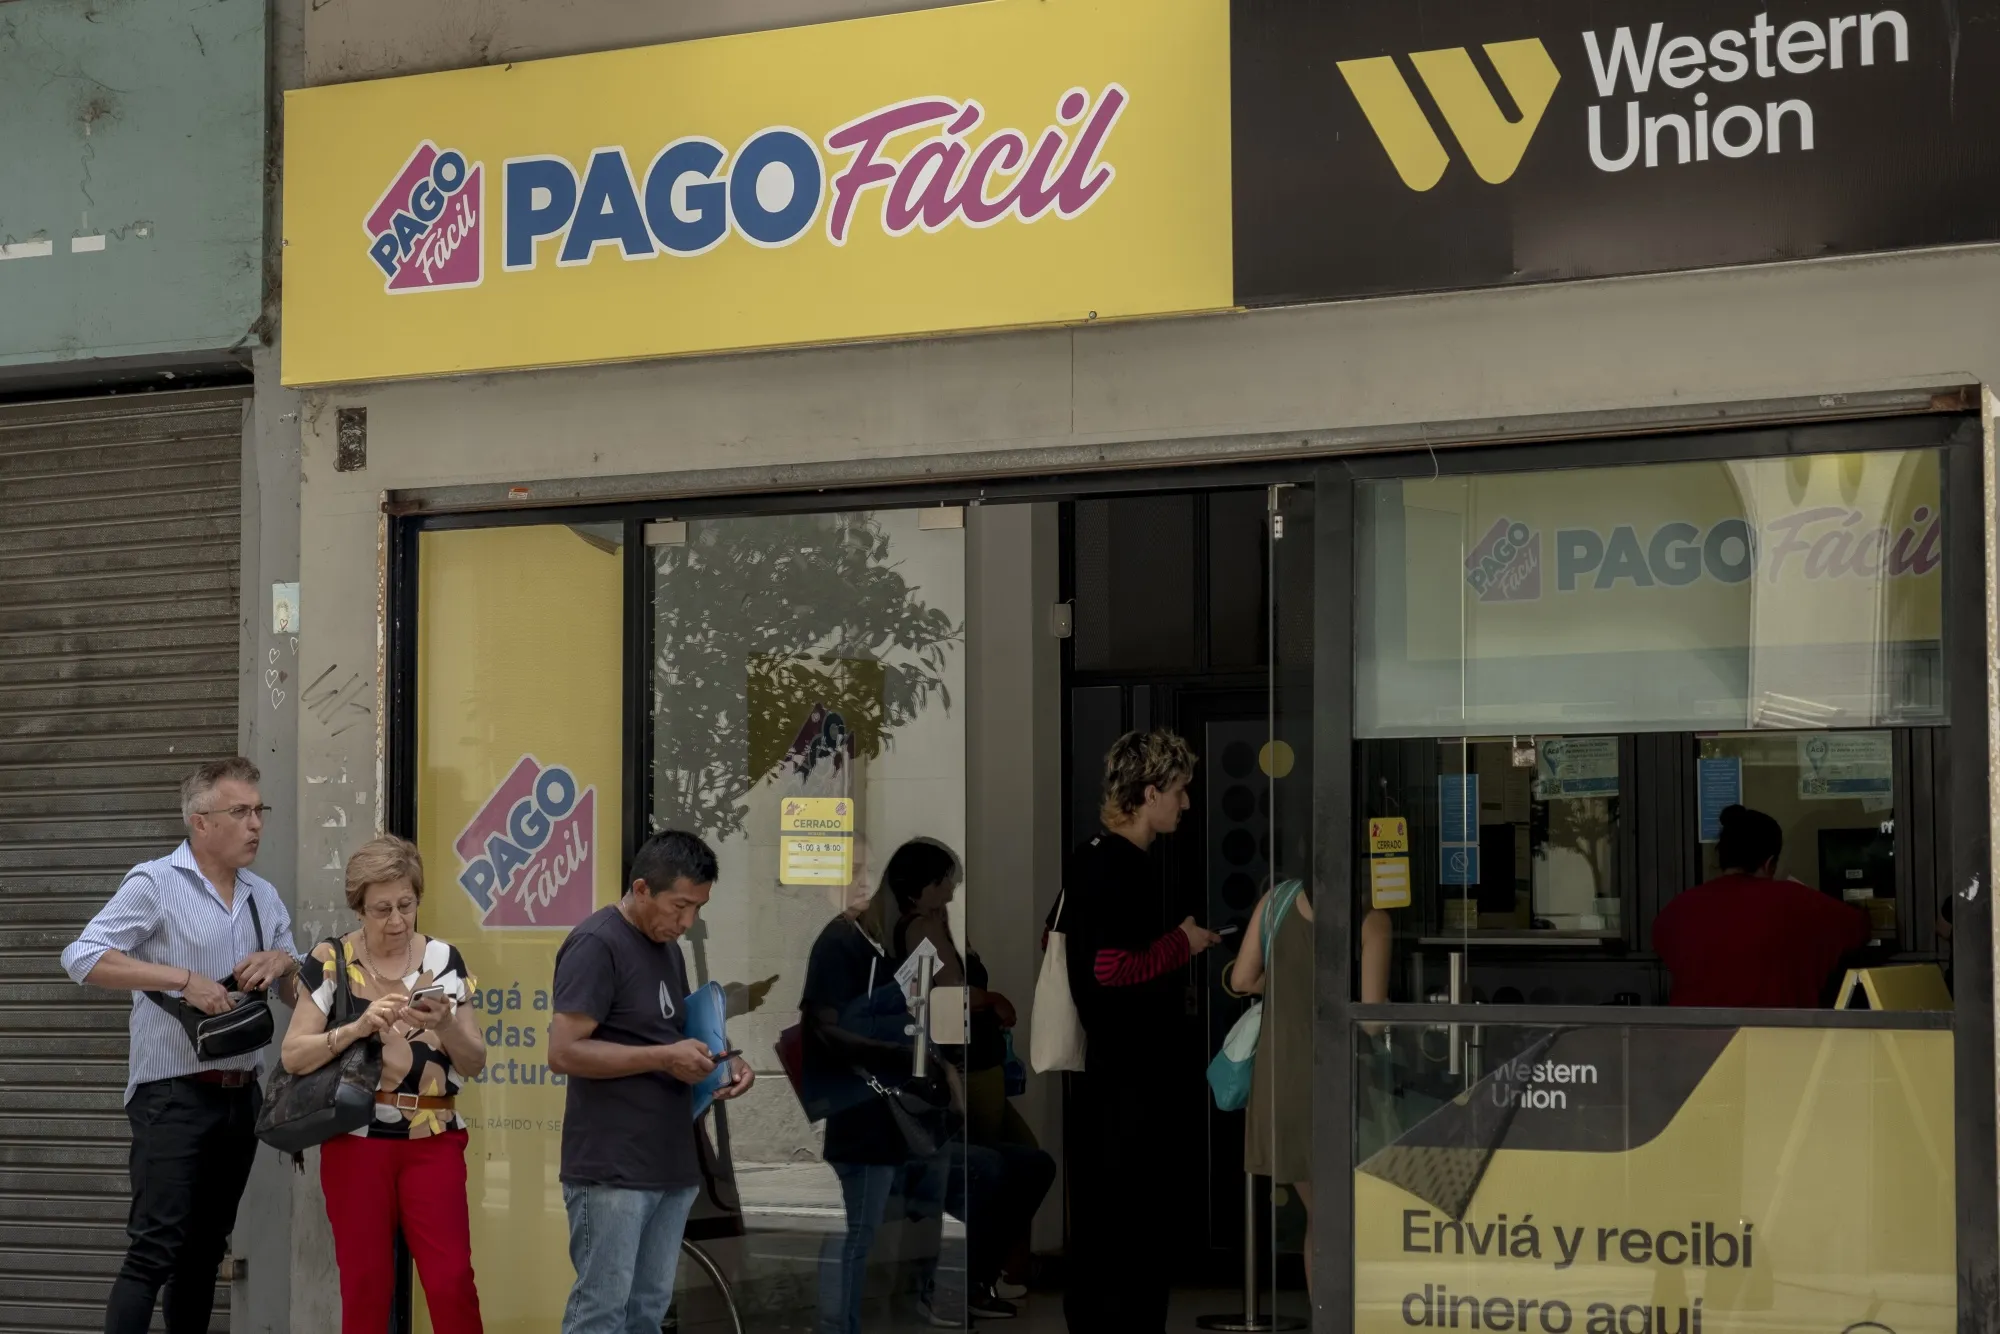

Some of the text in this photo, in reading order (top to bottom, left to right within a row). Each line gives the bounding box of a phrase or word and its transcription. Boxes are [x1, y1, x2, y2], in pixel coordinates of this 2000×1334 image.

[1582, 9, 1910, 97] Western
[1588, 92, 1815, 172] Union
[505, 85, 1127, 267] PAGO Fácil
[367, 149, 468, 279] PAGO
[414, 193, 477, 284] Fácil
[1466, 521, 1531, 596] PAGO
[1497, 547, 1538, 599] Fácil
[1556, 505, 1941, 591] PAGO Fácil
[458, 767, 577, 914] PAGO
[793, 819, 841, 829] CERRADO
[1376, 839, 1402, 850] CERRADO
[515, 820, 590, 924] Fácil
[471, 981, 521, 1015] agá
[480, 1019, 536, 1048] das
[1491, 1083, 1567, 1109] Union
[1493, 1058, 1598, 1084] Western
[463, 1117, 484, 1131] CIL,
[536, 1119, 543, 1130] Y
[546, 1120, 561, 1131] SE
[1402, 1209, 1754, 1270] Enviá y recibí
[1401, 1283, 1703, 1334] dinero aquí
